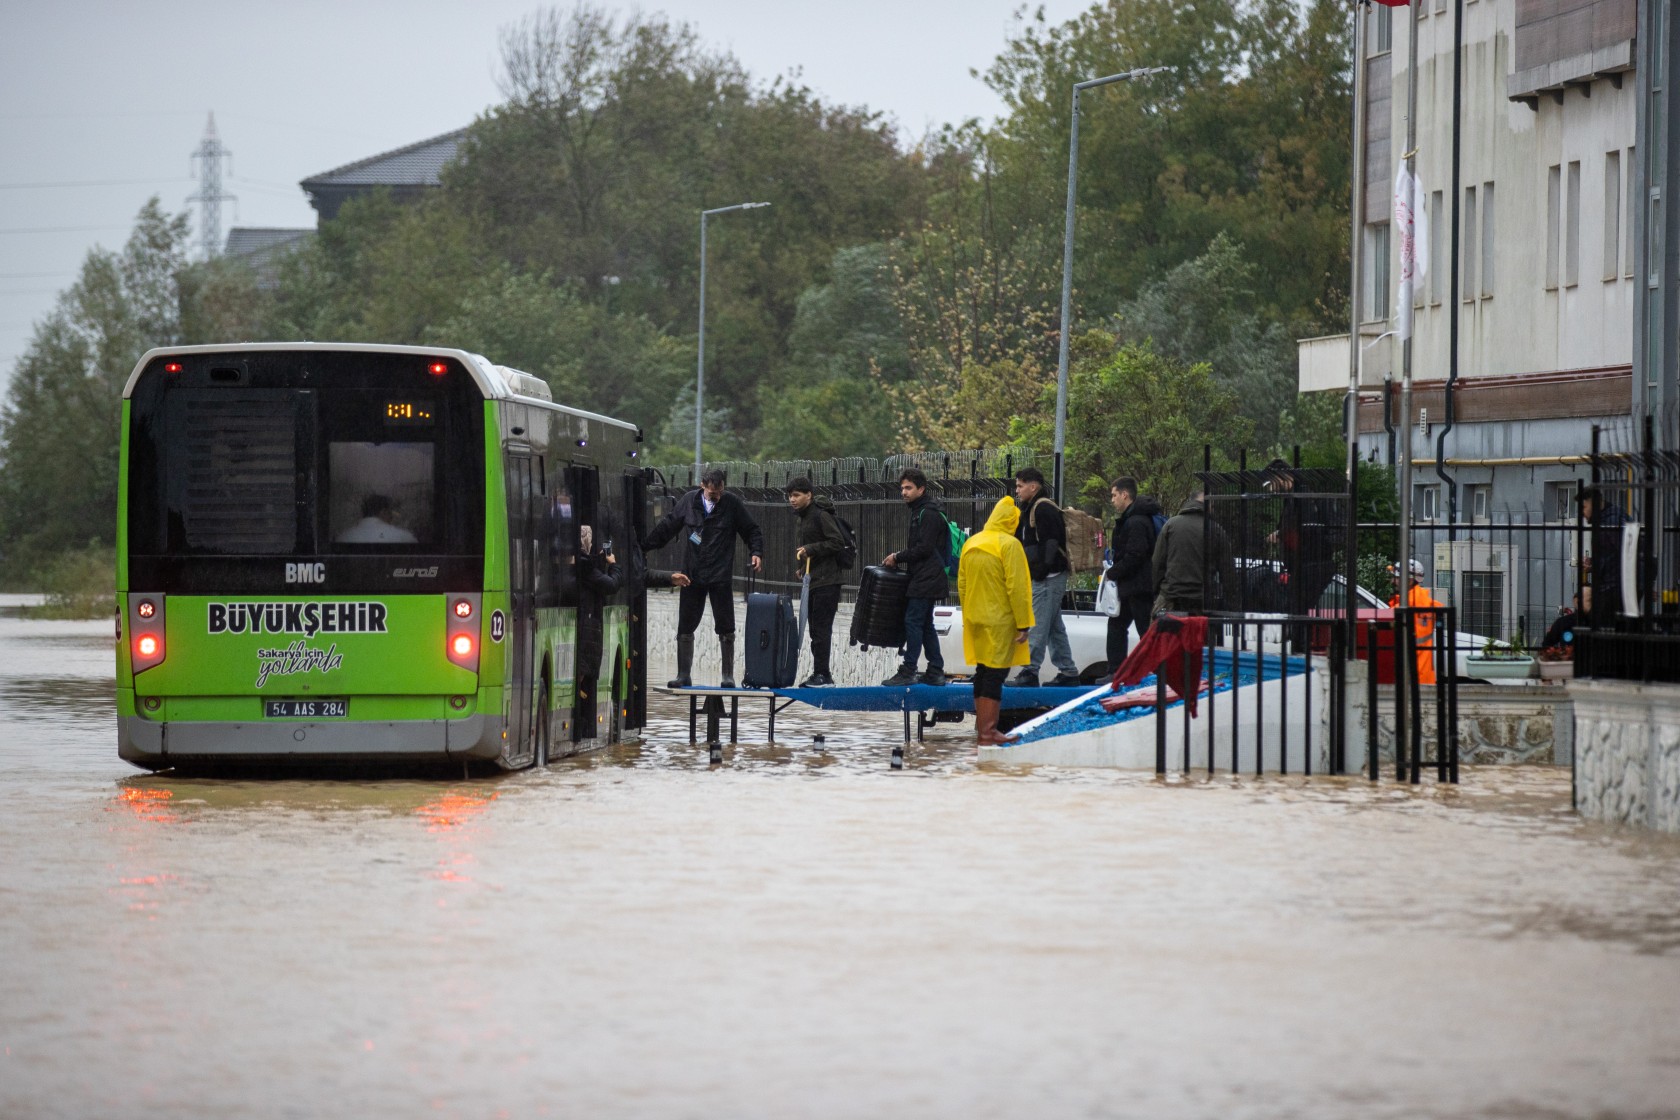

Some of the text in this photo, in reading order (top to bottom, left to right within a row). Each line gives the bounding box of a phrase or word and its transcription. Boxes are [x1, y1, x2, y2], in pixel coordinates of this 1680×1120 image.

[285, 562, 326, 583] BMC
[208, 602, 388, 638] BÜYÜKŞEHİR
[492, 615, 503, 637] 12
[256, 640, 343, 688] yollarda
[258, 649, 301, 660] Sakarya
[273, 703, 344, 716] 54 AAS 284
